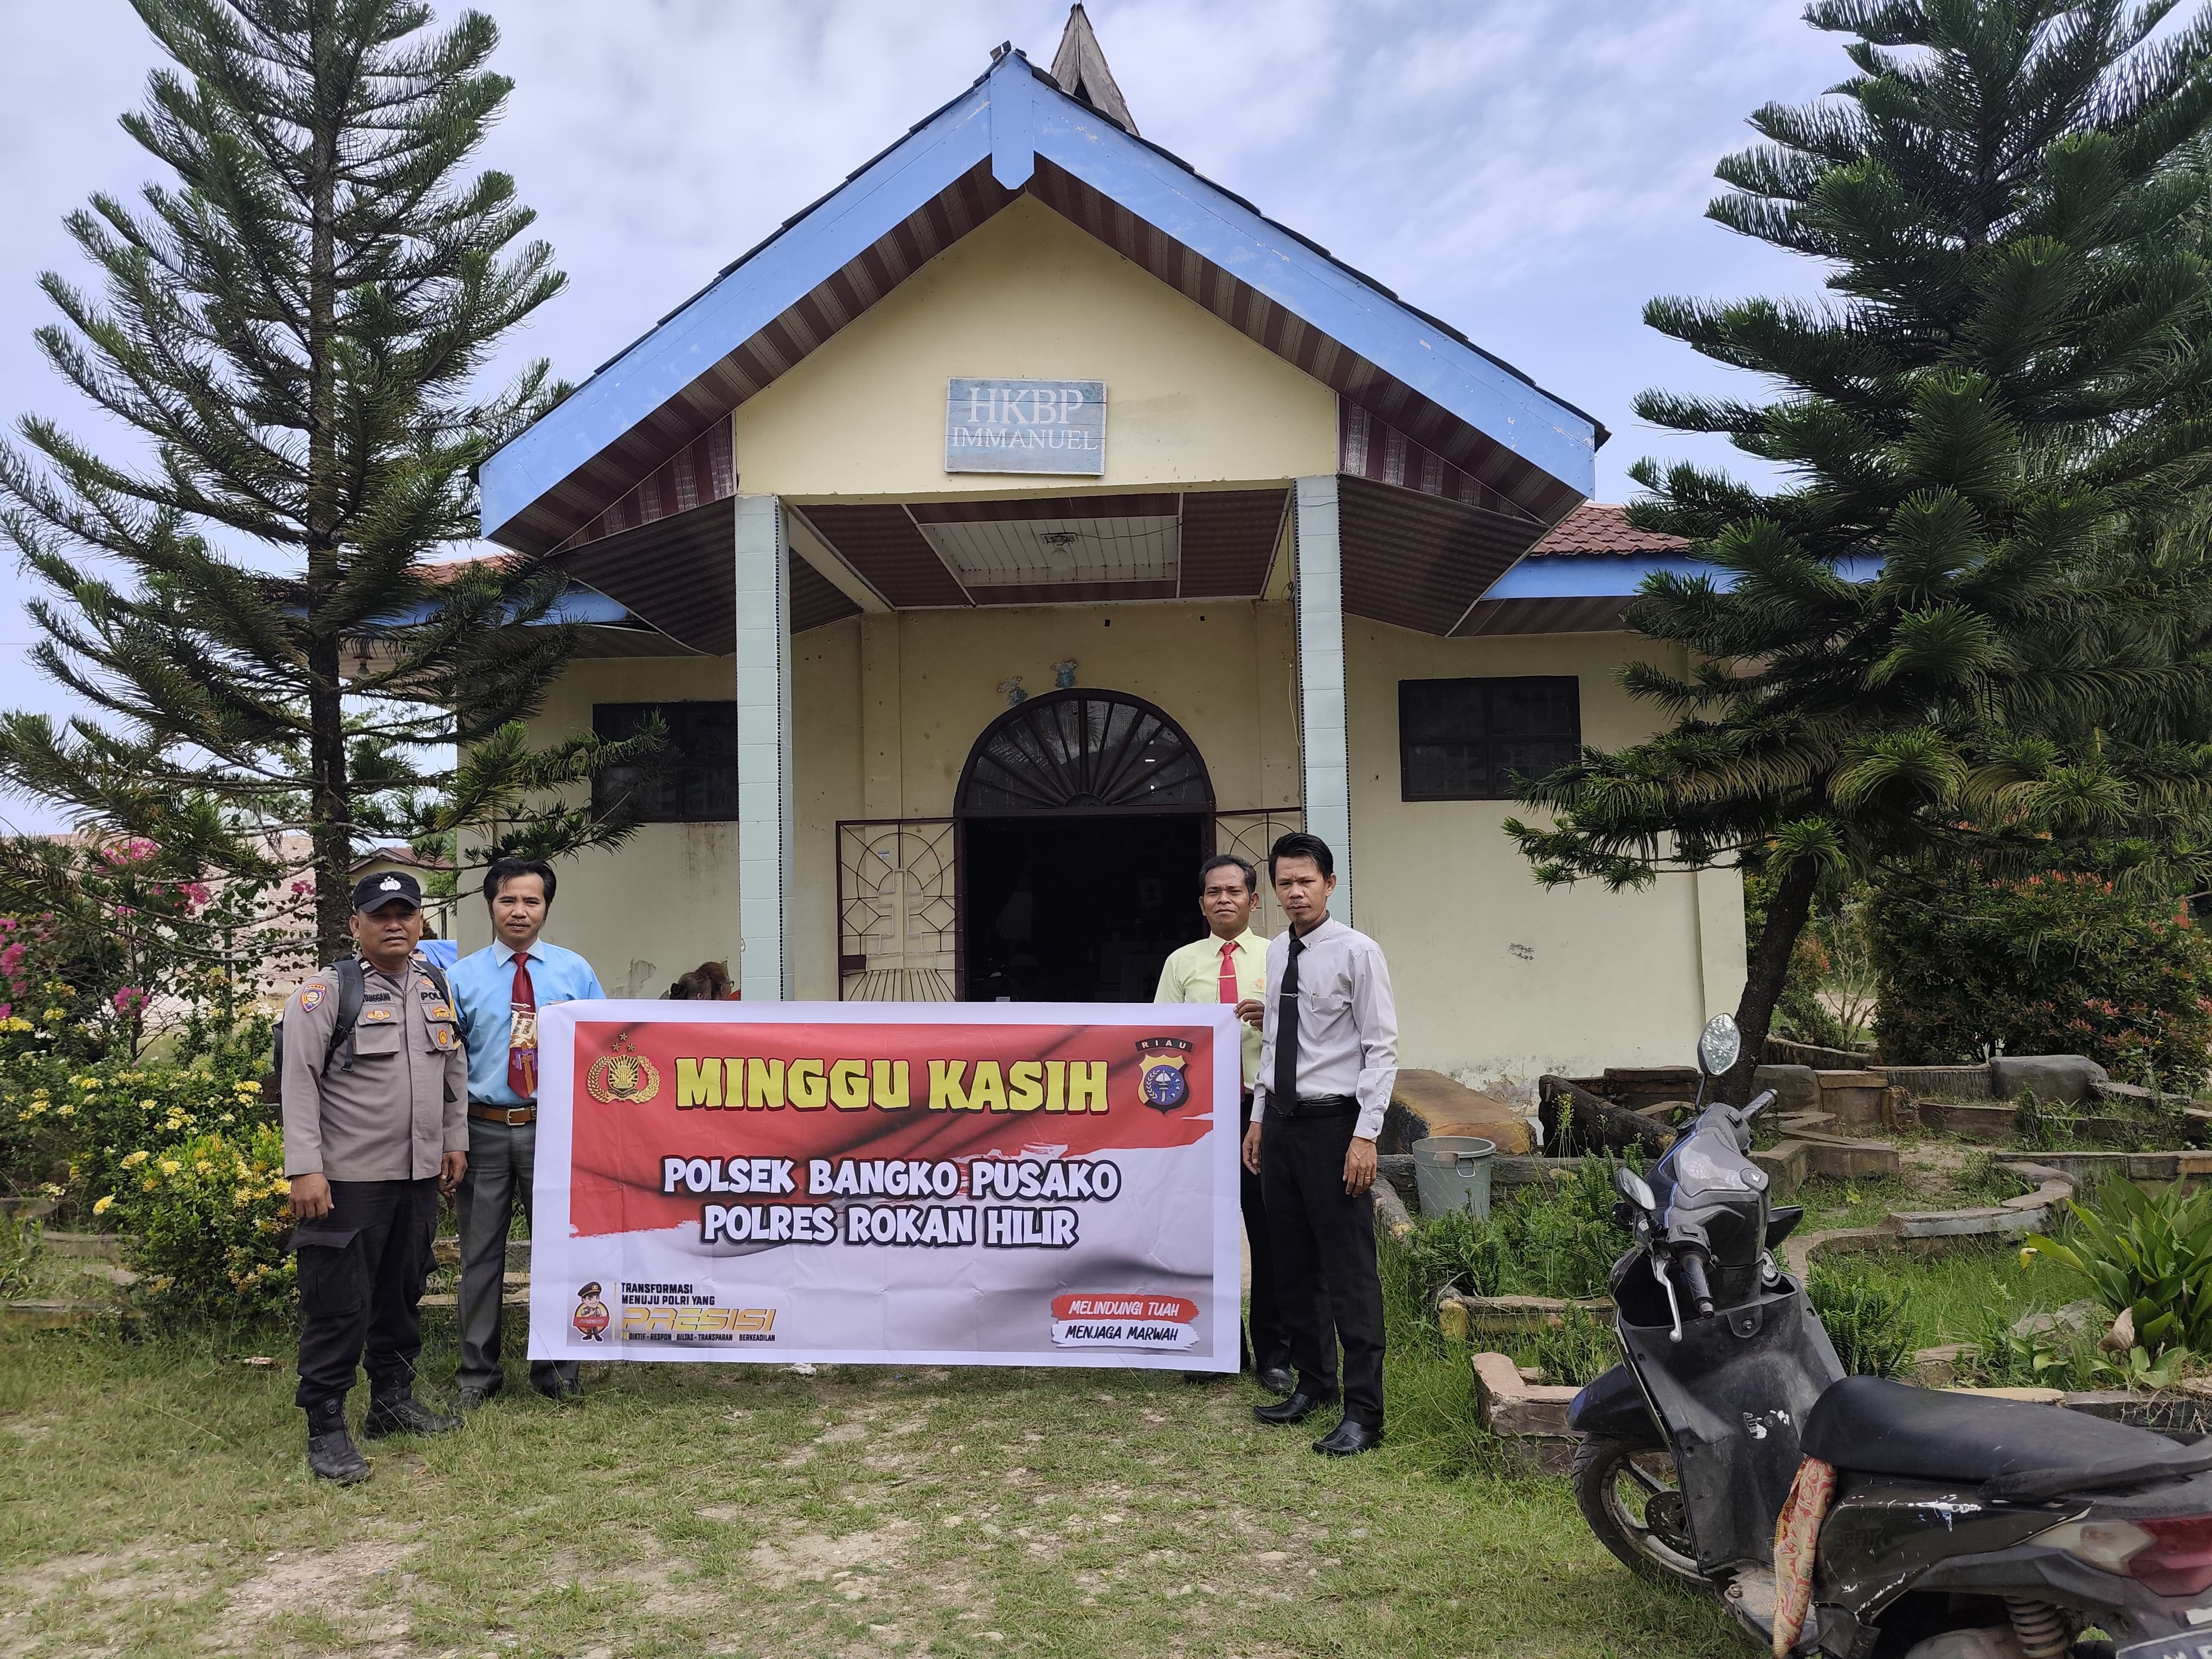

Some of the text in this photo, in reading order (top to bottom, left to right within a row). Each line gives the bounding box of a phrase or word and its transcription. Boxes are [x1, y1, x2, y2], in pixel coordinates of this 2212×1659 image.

[967, 388, 1084, 425] HKBP
[951, 427, 1099, 451] IMMANUEL
[1141, 1040, 1187, 1049] RIAU
[674, 1058, 1110, 1115] MINGGU KASIH
[663, 1156, 1119, 1198] POLSEK BANGKO PUSAKO
[704, 1205, 1076, 1246] POLRES ROKAN HILIR
[621, 1282, 693, 1294] TRANSFORMASI
[621, 1295, 715, 1306] MENUJU POLRI YANG
[1068, 1301, 1180, 1317] MELINDUNGI TUAH
[621, 1307, 776, 1331] PRESISI
[1065, 1326, 1179, 1341] MENJAGA MARWAH
